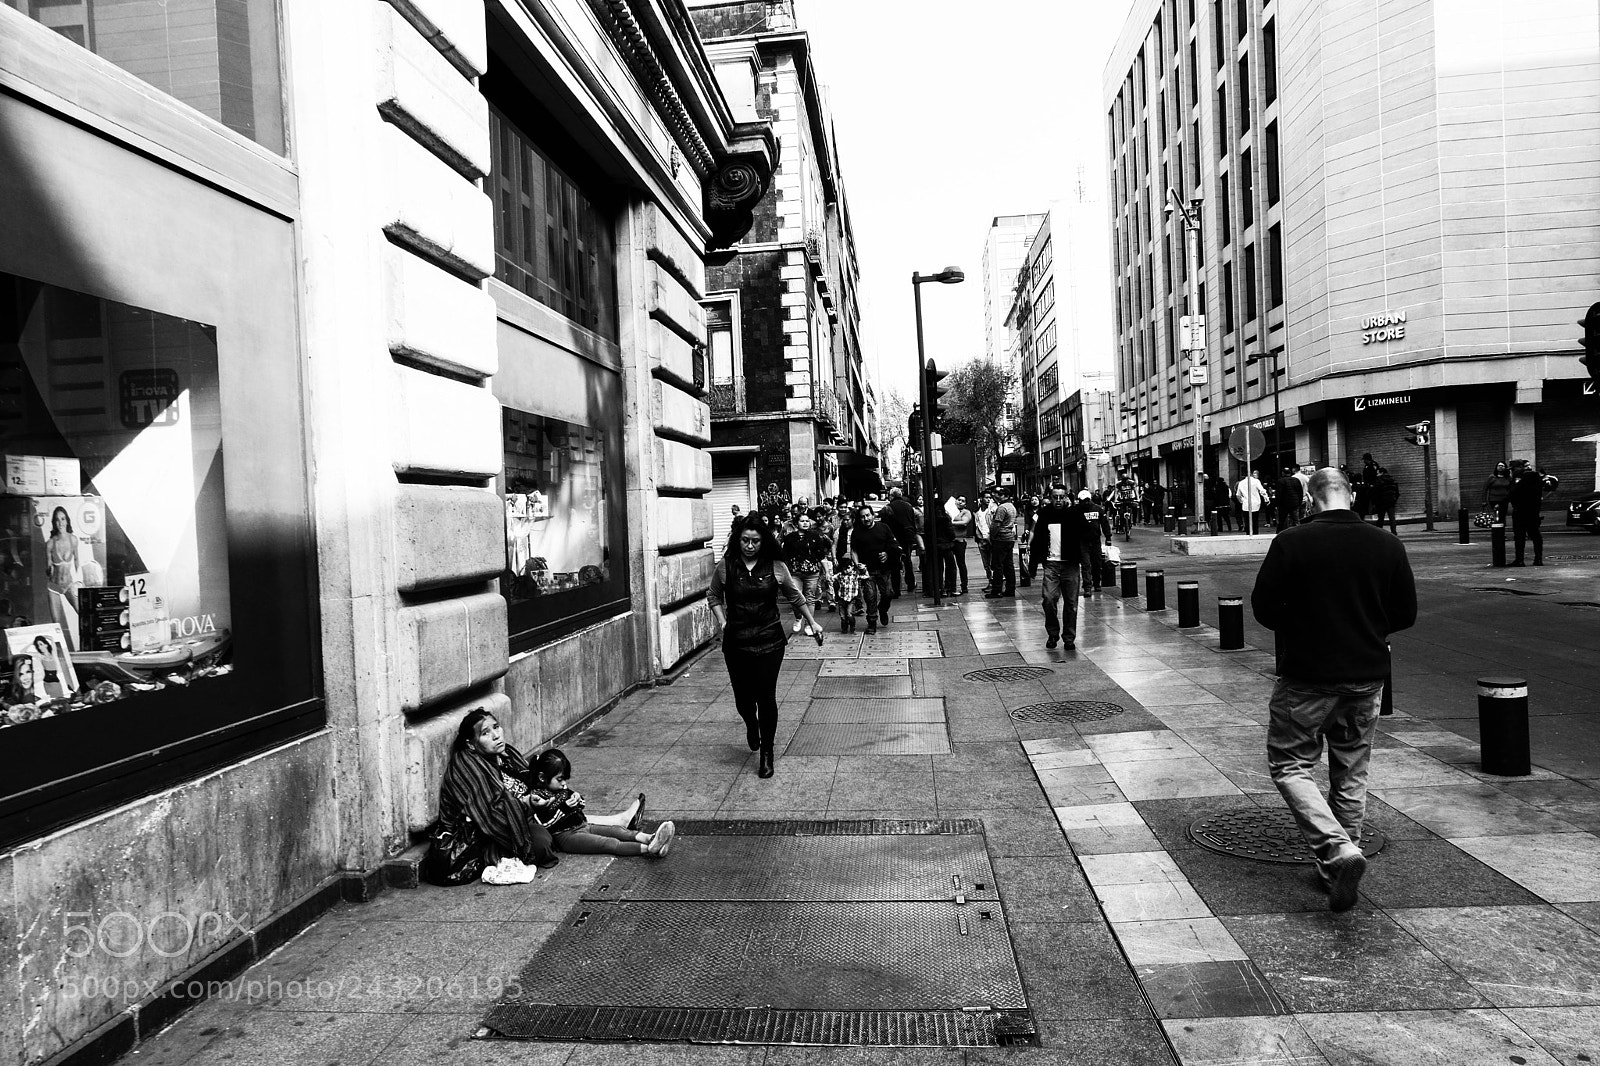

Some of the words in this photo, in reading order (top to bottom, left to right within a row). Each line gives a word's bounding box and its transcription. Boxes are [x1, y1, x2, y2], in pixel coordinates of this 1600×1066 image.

[1361, 311, 1406, 330] URBAN
[1363, 327, 1405, 345] STORE
[1367, 395, 1411, 407] LIZMINELLI
[130, 399, 167, 423] TV
[130, 578, 147, 596] 12
